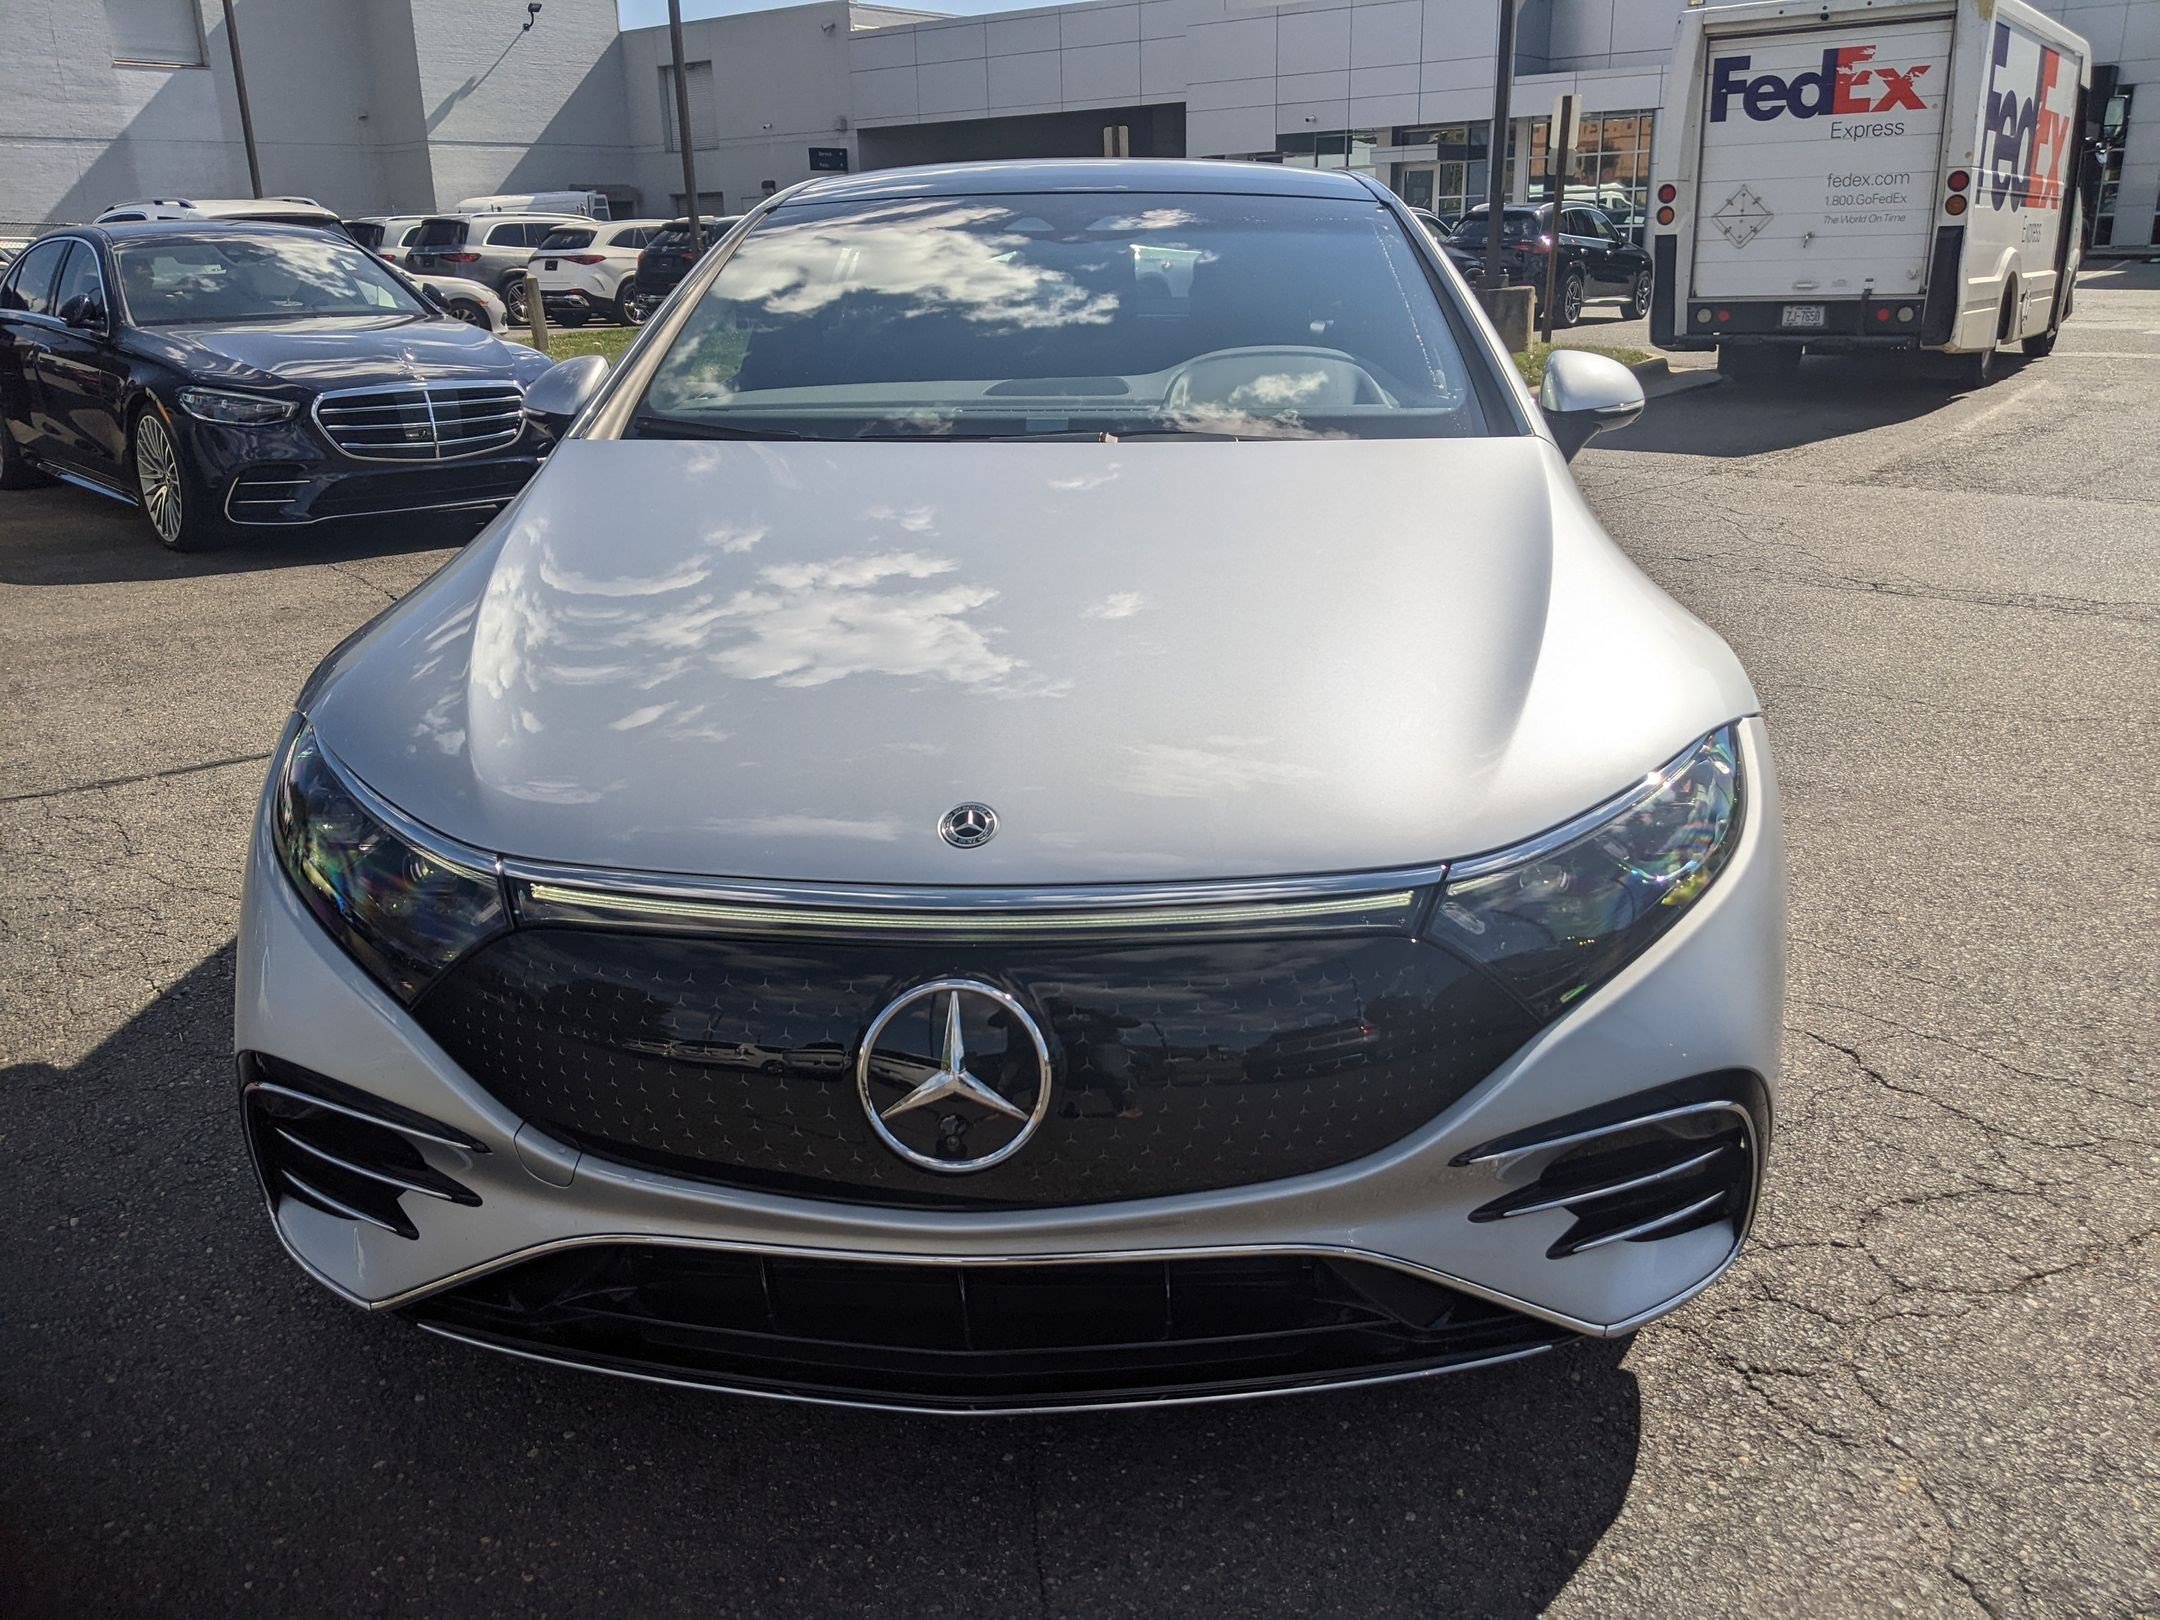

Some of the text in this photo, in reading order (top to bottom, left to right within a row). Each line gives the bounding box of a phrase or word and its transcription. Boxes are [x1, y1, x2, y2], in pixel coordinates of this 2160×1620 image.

[1710, 45, 1931, 123] FedEx
[1975, 21, 2070, 213] FedEx
[1830, 121, 1905, 141] Express
[1827, 172, 1910, 188] fedex.com
[1825, 192, 1907, 207] 1.800.GoFedEx
[1824, 213, 1906, 224] The World On Time
